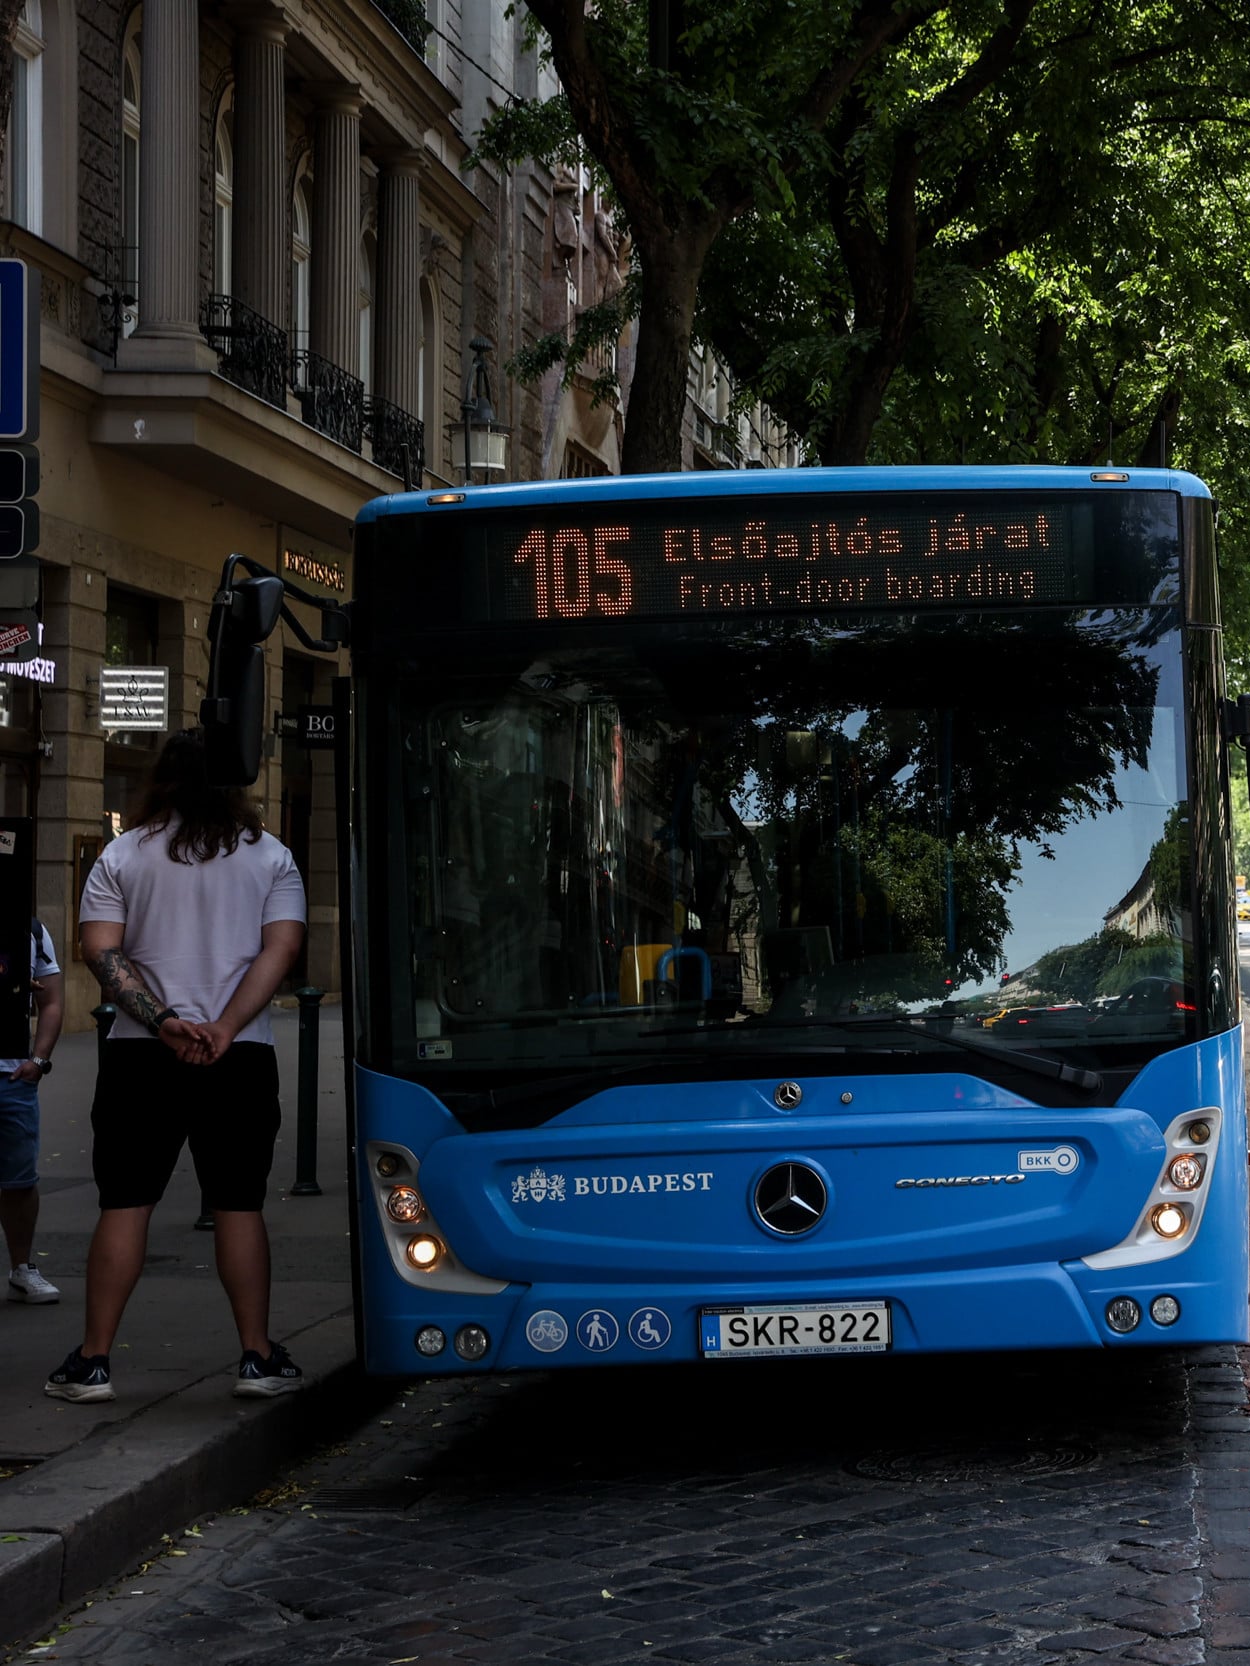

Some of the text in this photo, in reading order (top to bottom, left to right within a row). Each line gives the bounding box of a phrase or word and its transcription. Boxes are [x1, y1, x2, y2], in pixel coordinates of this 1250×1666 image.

[665, 513, 1049, 562] Elsőajtós járat
[514, 527, 632, 618] 105
[680, 563, 1034, 608] Front-door boarding
[0, 627, 20, 642] URVE
[1026, 1156, 1052, 1166] BKK
[574, 1172, 714, 1196] BUDAPEST
[895, 1173, 1026, 1189] CONECTO
[707, 1335, 717, 1347] H
[728, 1312, 881, 1348] SKR-822
